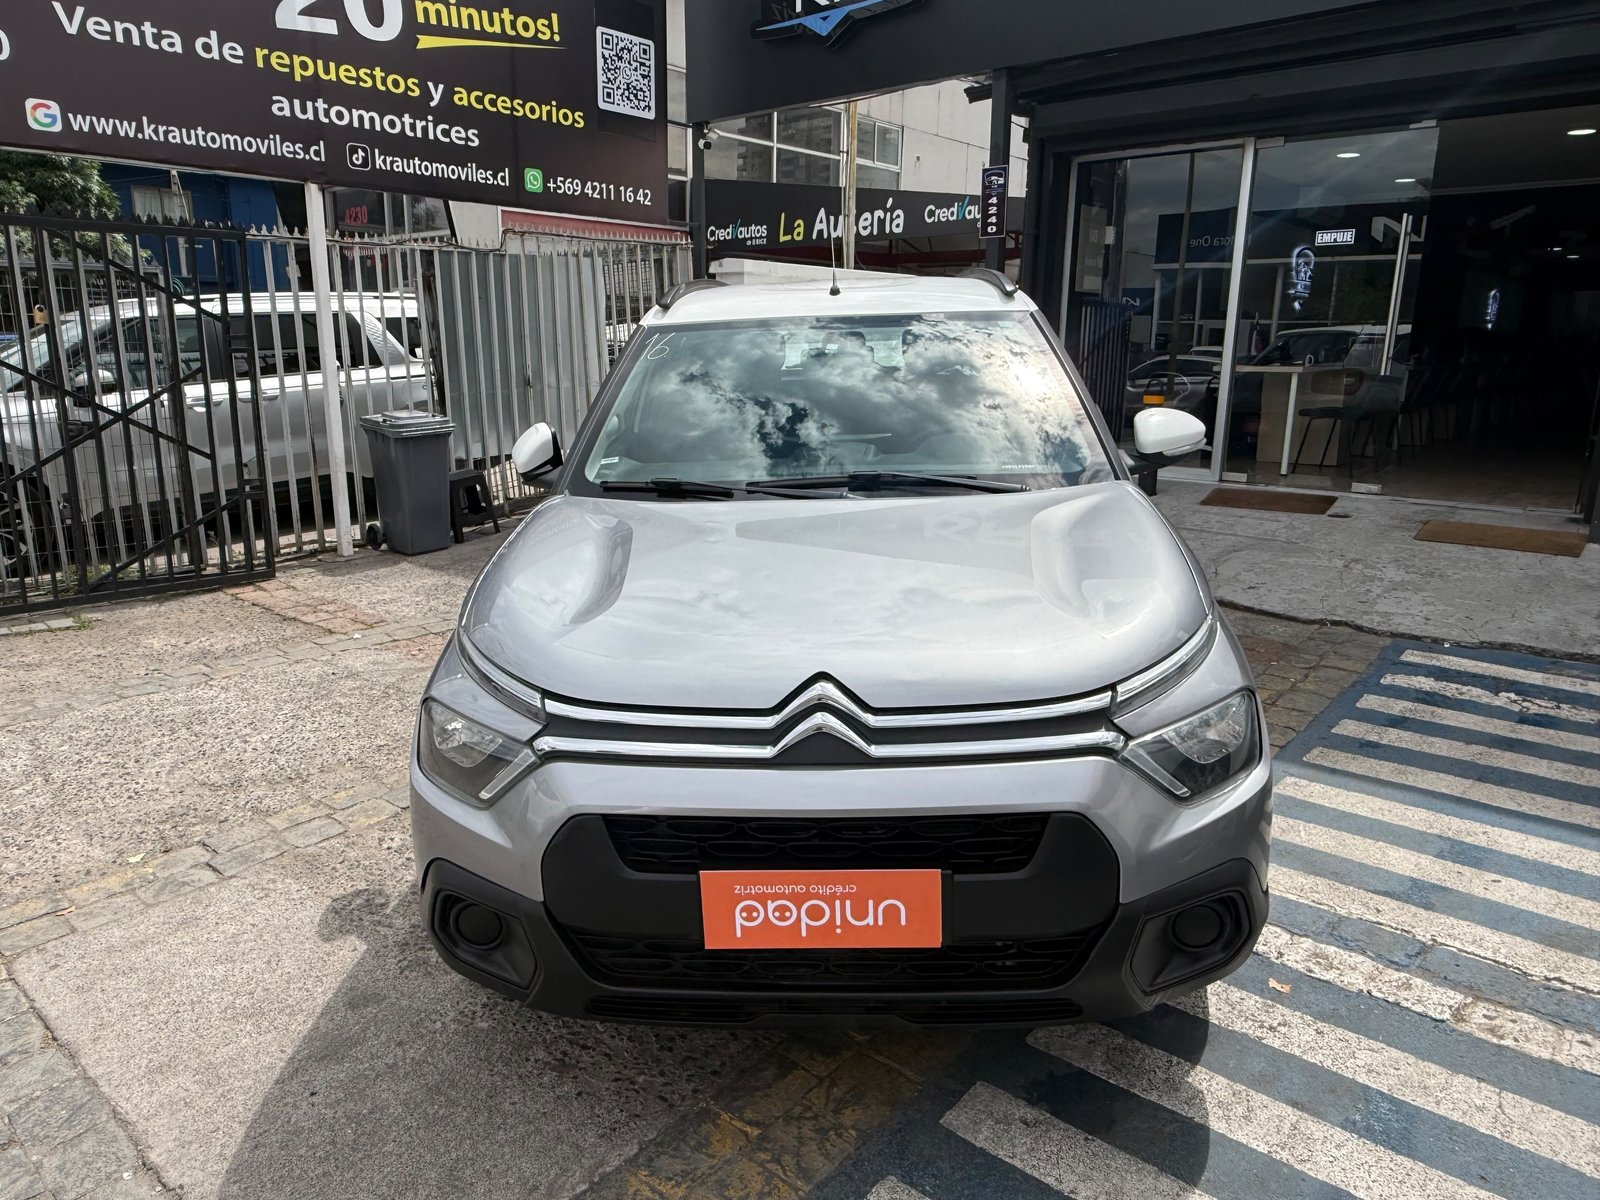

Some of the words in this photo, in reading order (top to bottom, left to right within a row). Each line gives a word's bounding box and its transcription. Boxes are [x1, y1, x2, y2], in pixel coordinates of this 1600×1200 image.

[415, 0, 561, 42] minutos!
[52, 1, 183, 54] Venta
[194, 30, 244, 64] de
[255, 47, 420, 97] repuestos
[427, 81, 444, 107] y
[453, 86, 585, 128] accesorios
[67, 112, 326, 162] www.krautomoviles.cl
[271, 95, 480, 147] automotrices
[374, 149, 510, 187] krautomoviles.cl
[547, 178, 581, 196] +569
[584, 181, 616, 201] 4211
[619, 185, 635, 203] 16
[636, 189, 652, 205] 42
[779, 212, 804, 243] La
[812, 197, 904, 241] Auería
[987, 196, 998, 233] 4240
[1317, 231, 1353, 243] EMPUJE
[734, 884, 806, 895] automotriz
[809, 884, 857, 896] crédito
[735, 900, 906, 938] unidad
